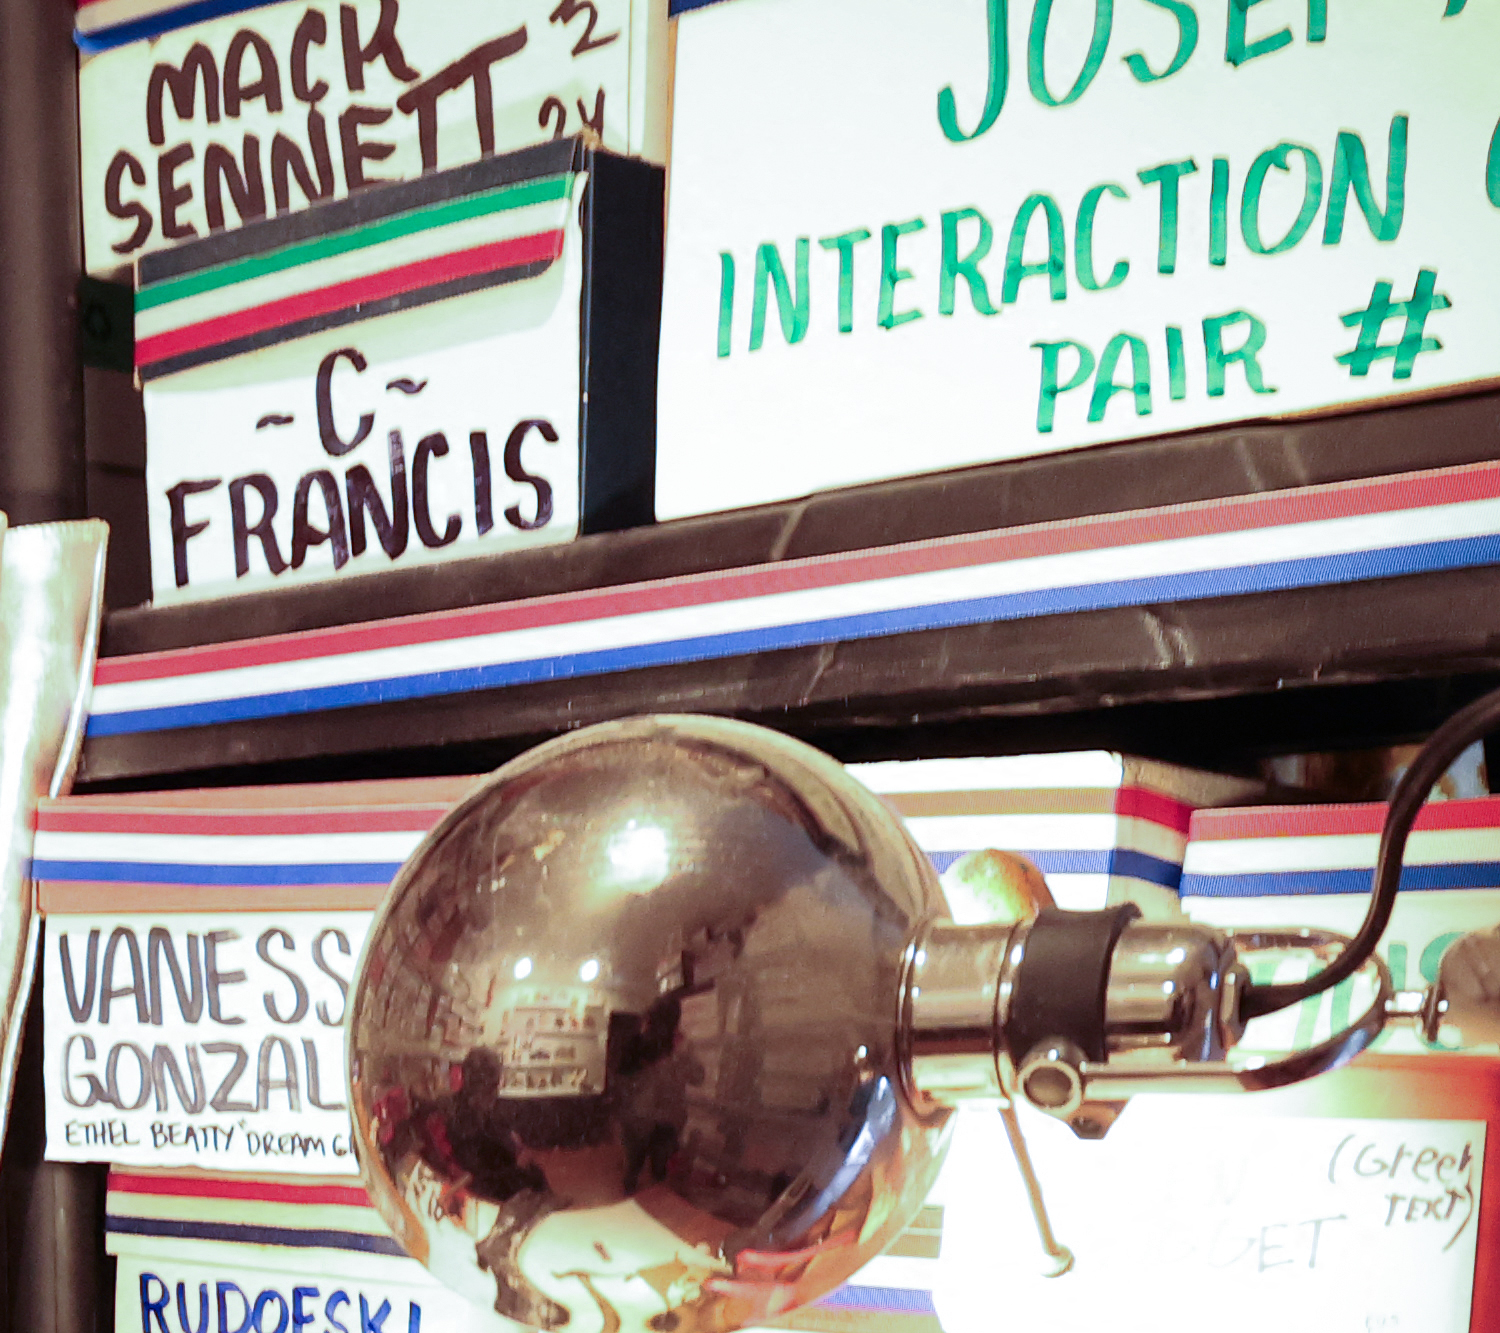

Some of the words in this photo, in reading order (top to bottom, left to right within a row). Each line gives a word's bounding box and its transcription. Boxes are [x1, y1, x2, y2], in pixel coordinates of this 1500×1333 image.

[104, 25, 528, 254] SENNETT
[147, 0, 421, 145] MACK
[716, 112, 1408, 360] INTERACTION
[1033, 308, 1279, 436] PAIR
[1337, 266, 1454, 384] #
[165, 418, 559, 588] FRANCIS
[65, 1120, 140, 1147] ETHEL
[150, 1122, 235, 1153] BEATTY
